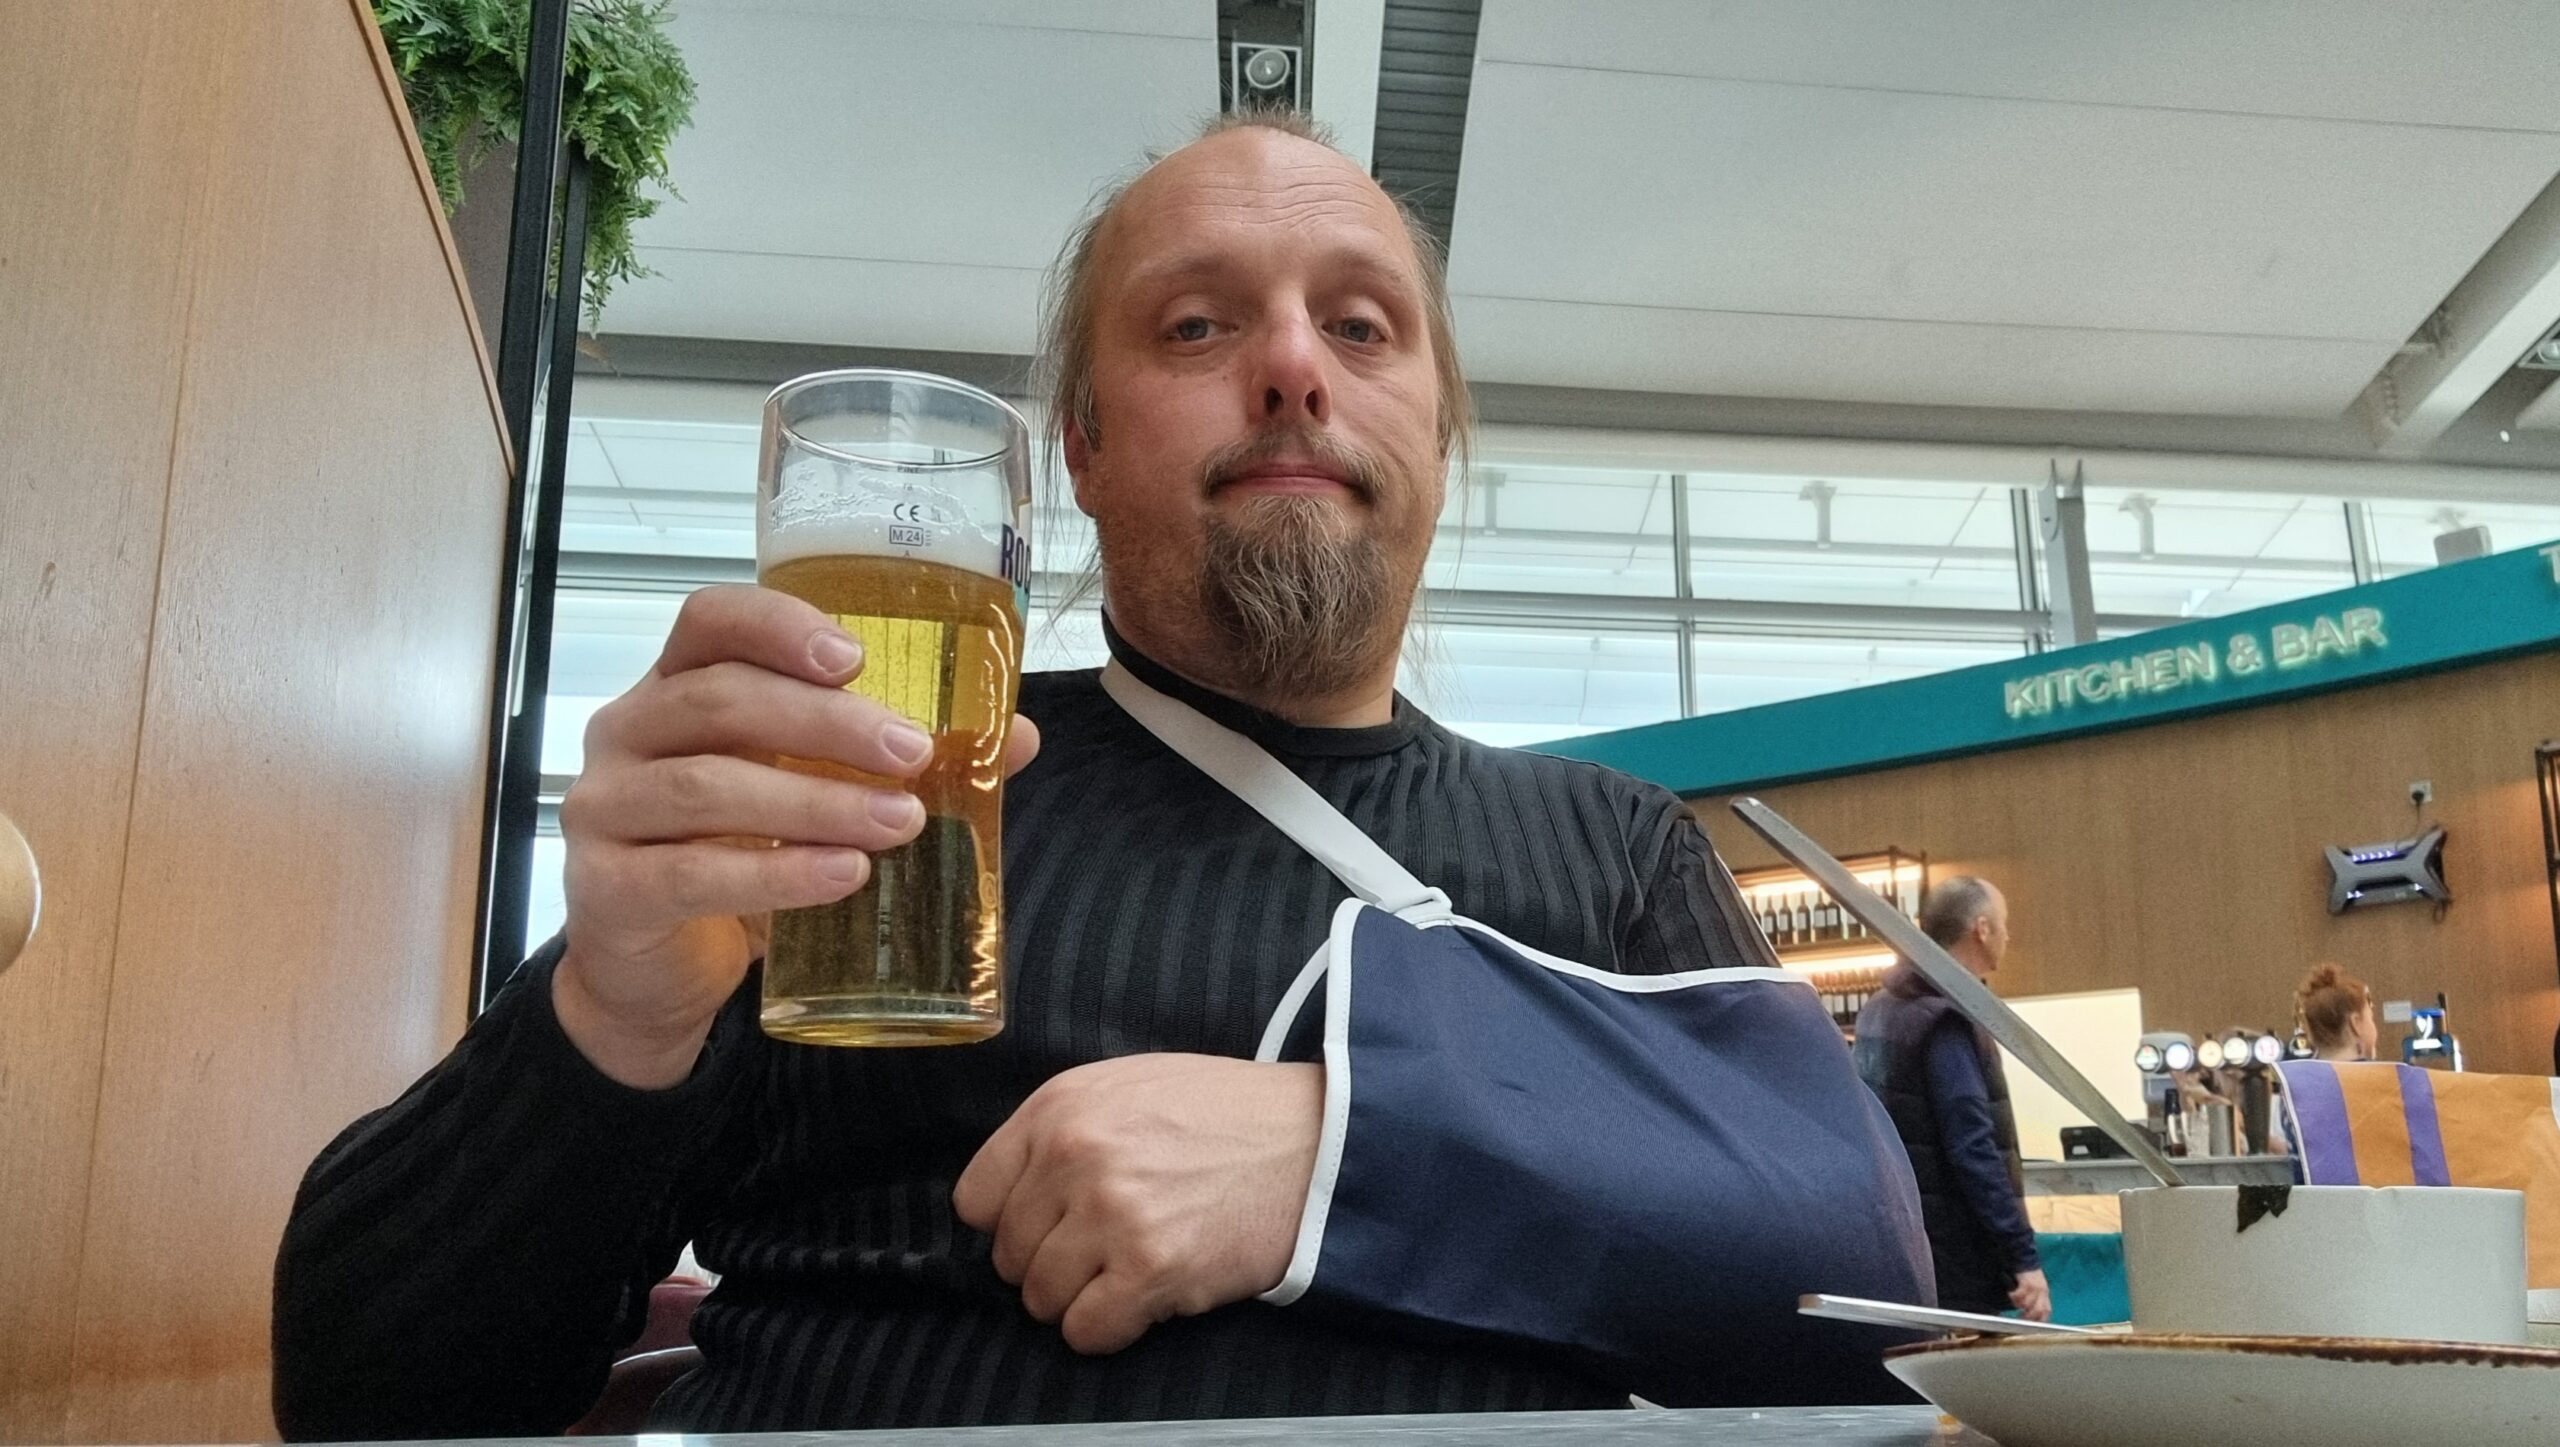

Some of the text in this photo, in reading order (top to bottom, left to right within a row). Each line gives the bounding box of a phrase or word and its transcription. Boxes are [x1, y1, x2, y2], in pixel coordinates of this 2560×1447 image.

[893, 503, 920, 522] CE
[892, 529, 904, 541] M
[906, 529, 920, 542] 24
[2004, 607, 2387, 717] KITCHEN & BAR
